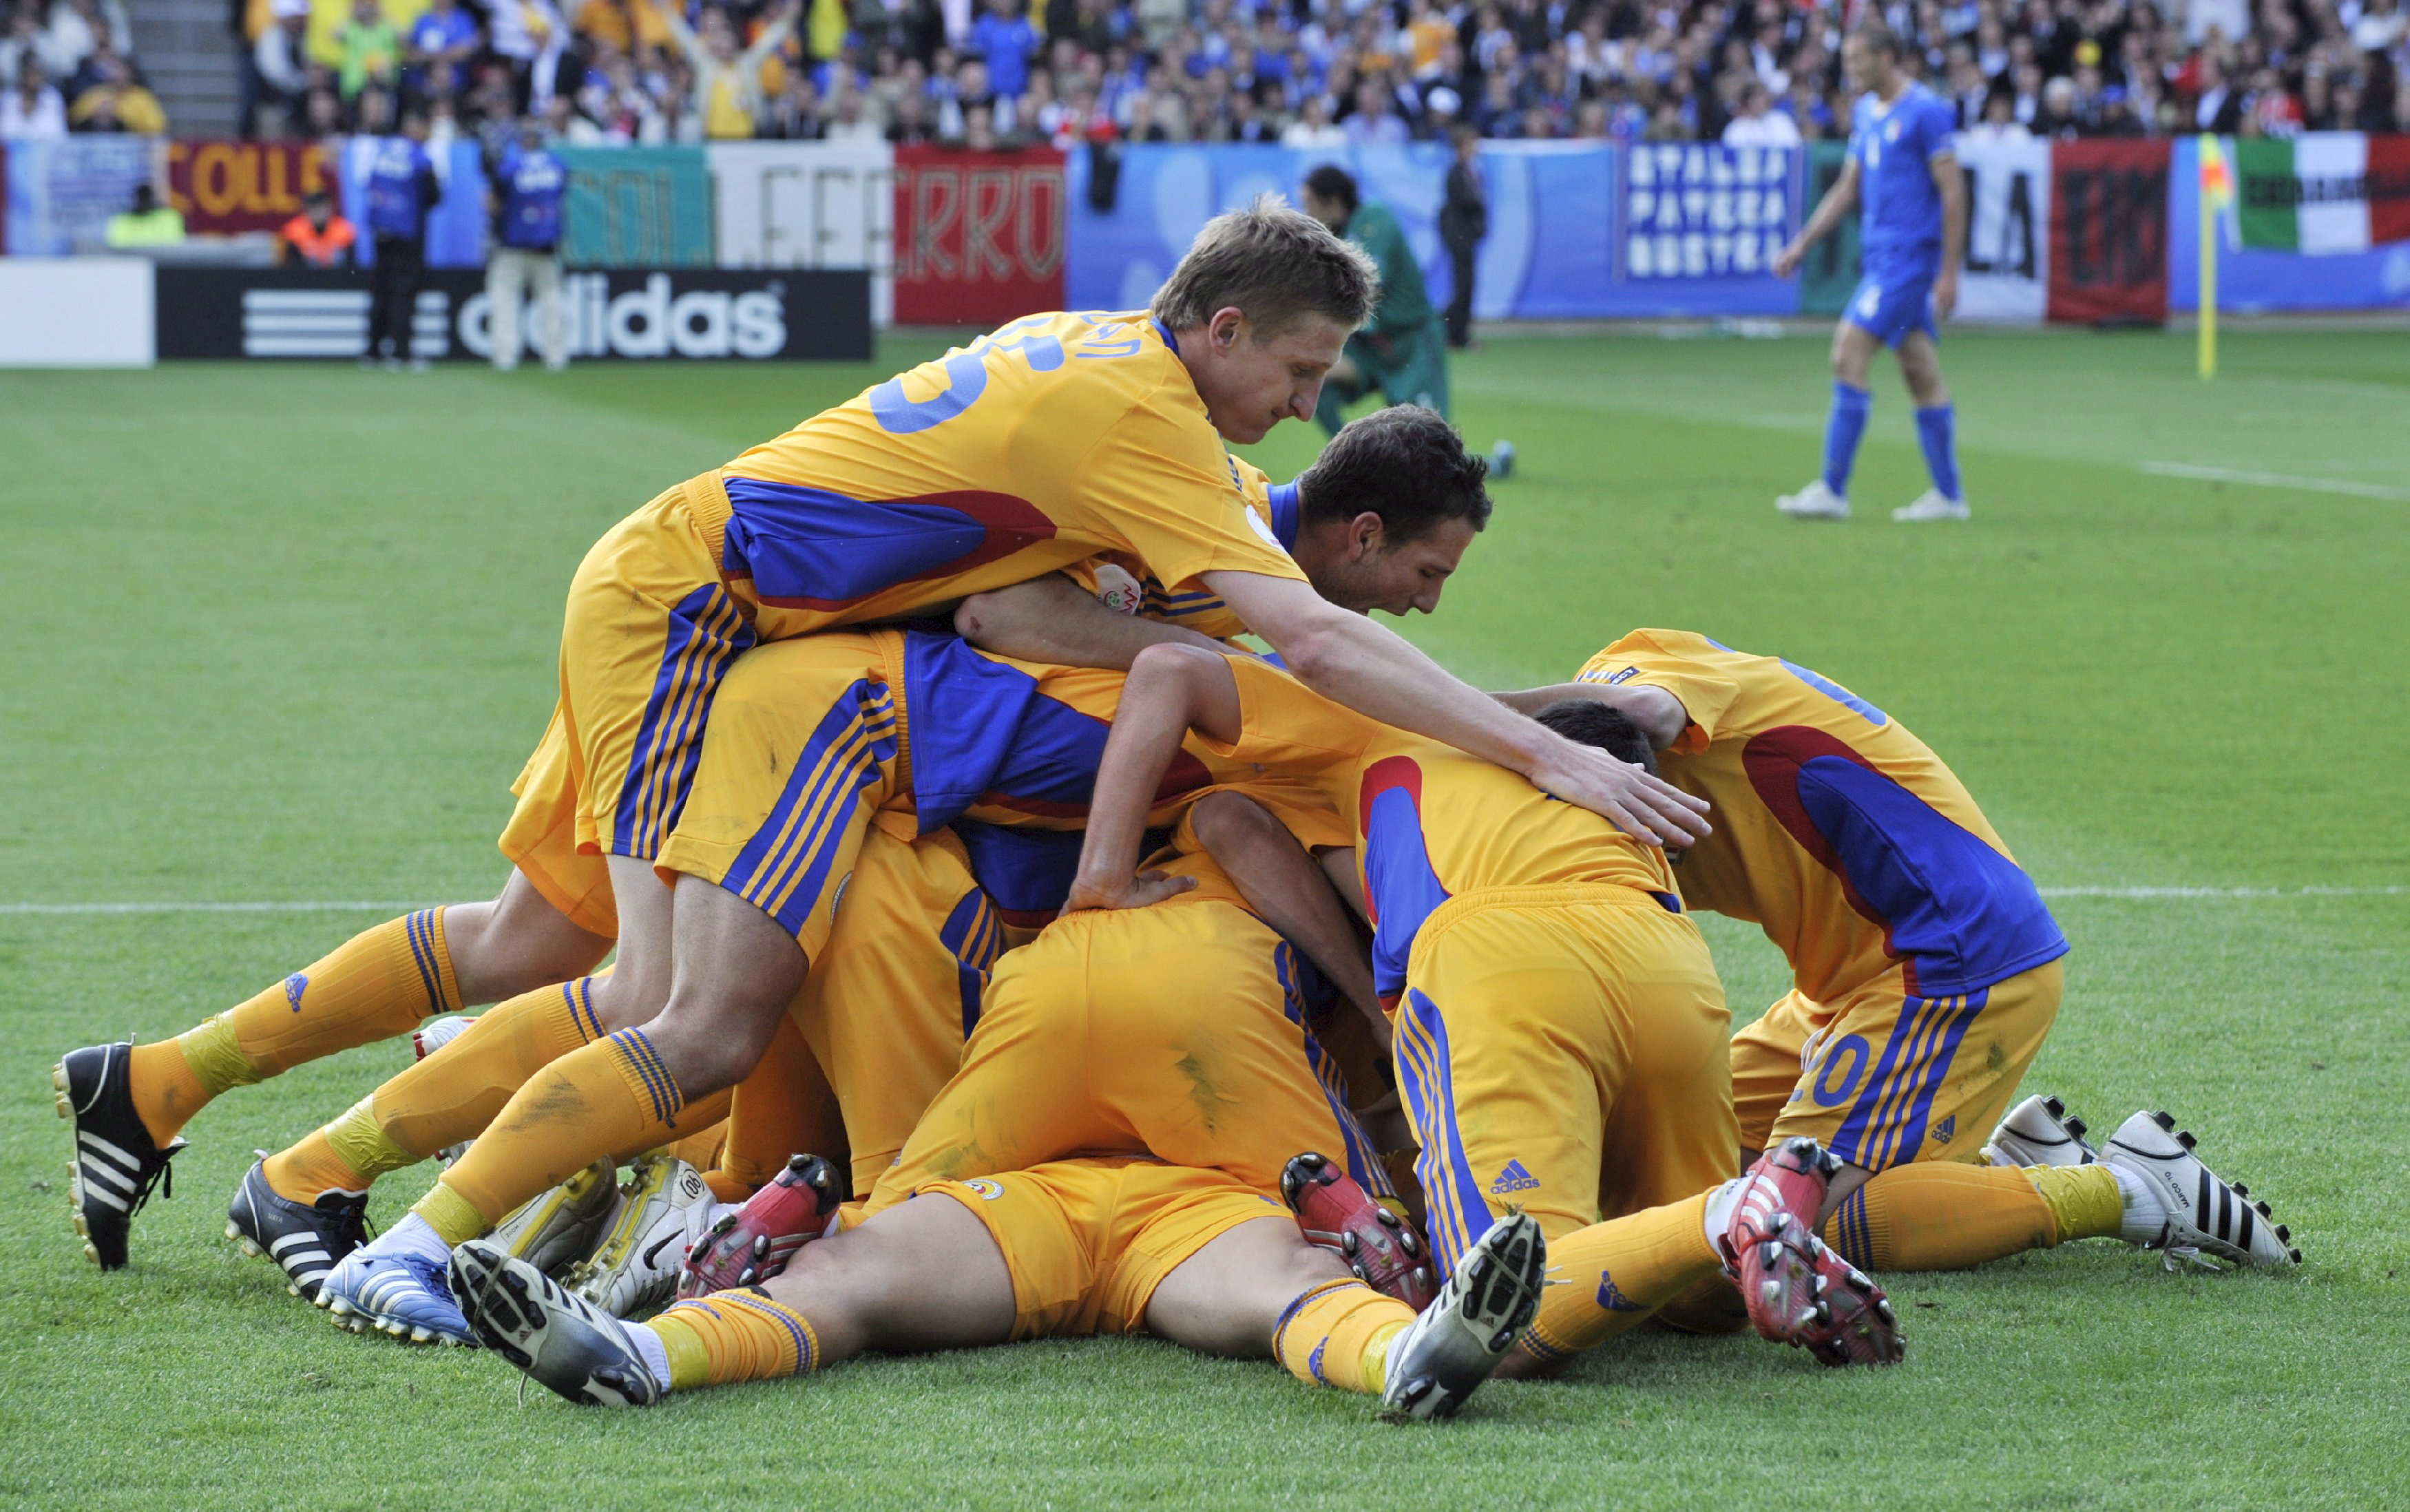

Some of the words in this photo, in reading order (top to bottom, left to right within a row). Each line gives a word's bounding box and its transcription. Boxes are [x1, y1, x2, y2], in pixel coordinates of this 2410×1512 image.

[457, 273, 787, 357] adidas
[1490, 1178, 1540, 1195] adidas
[2165, 1172, 2173, 1180] 10
[2172, 1183, 2190, 1208] MARCO
